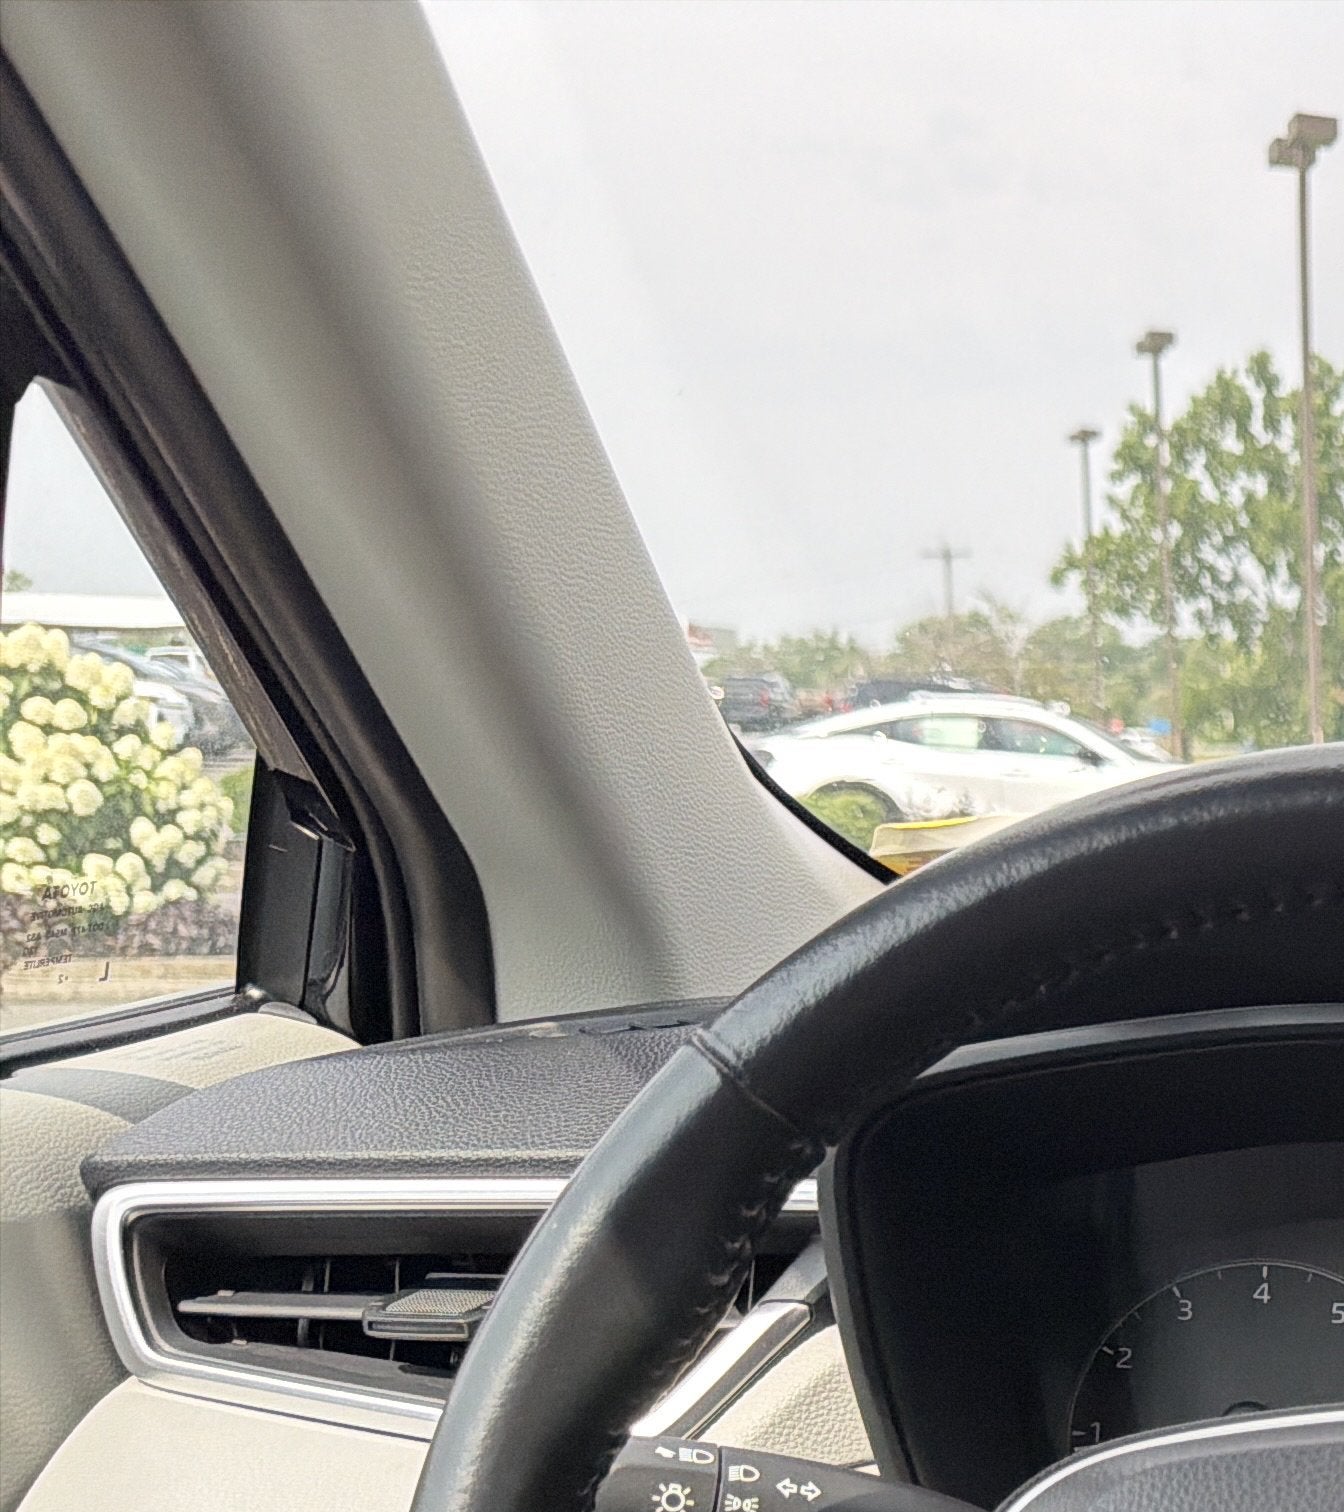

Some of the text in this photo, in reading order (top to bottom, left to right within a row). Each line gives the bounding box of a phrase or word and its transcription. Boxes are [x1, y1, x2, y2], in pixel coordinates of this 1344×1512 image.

[1252, 1282, 1272, 1304] 4
[1177, 1299, 1193, 1321] 3
[1115, 1347, 1133, 1370] 2
[1090, 1421, 1102, 1444] 1
